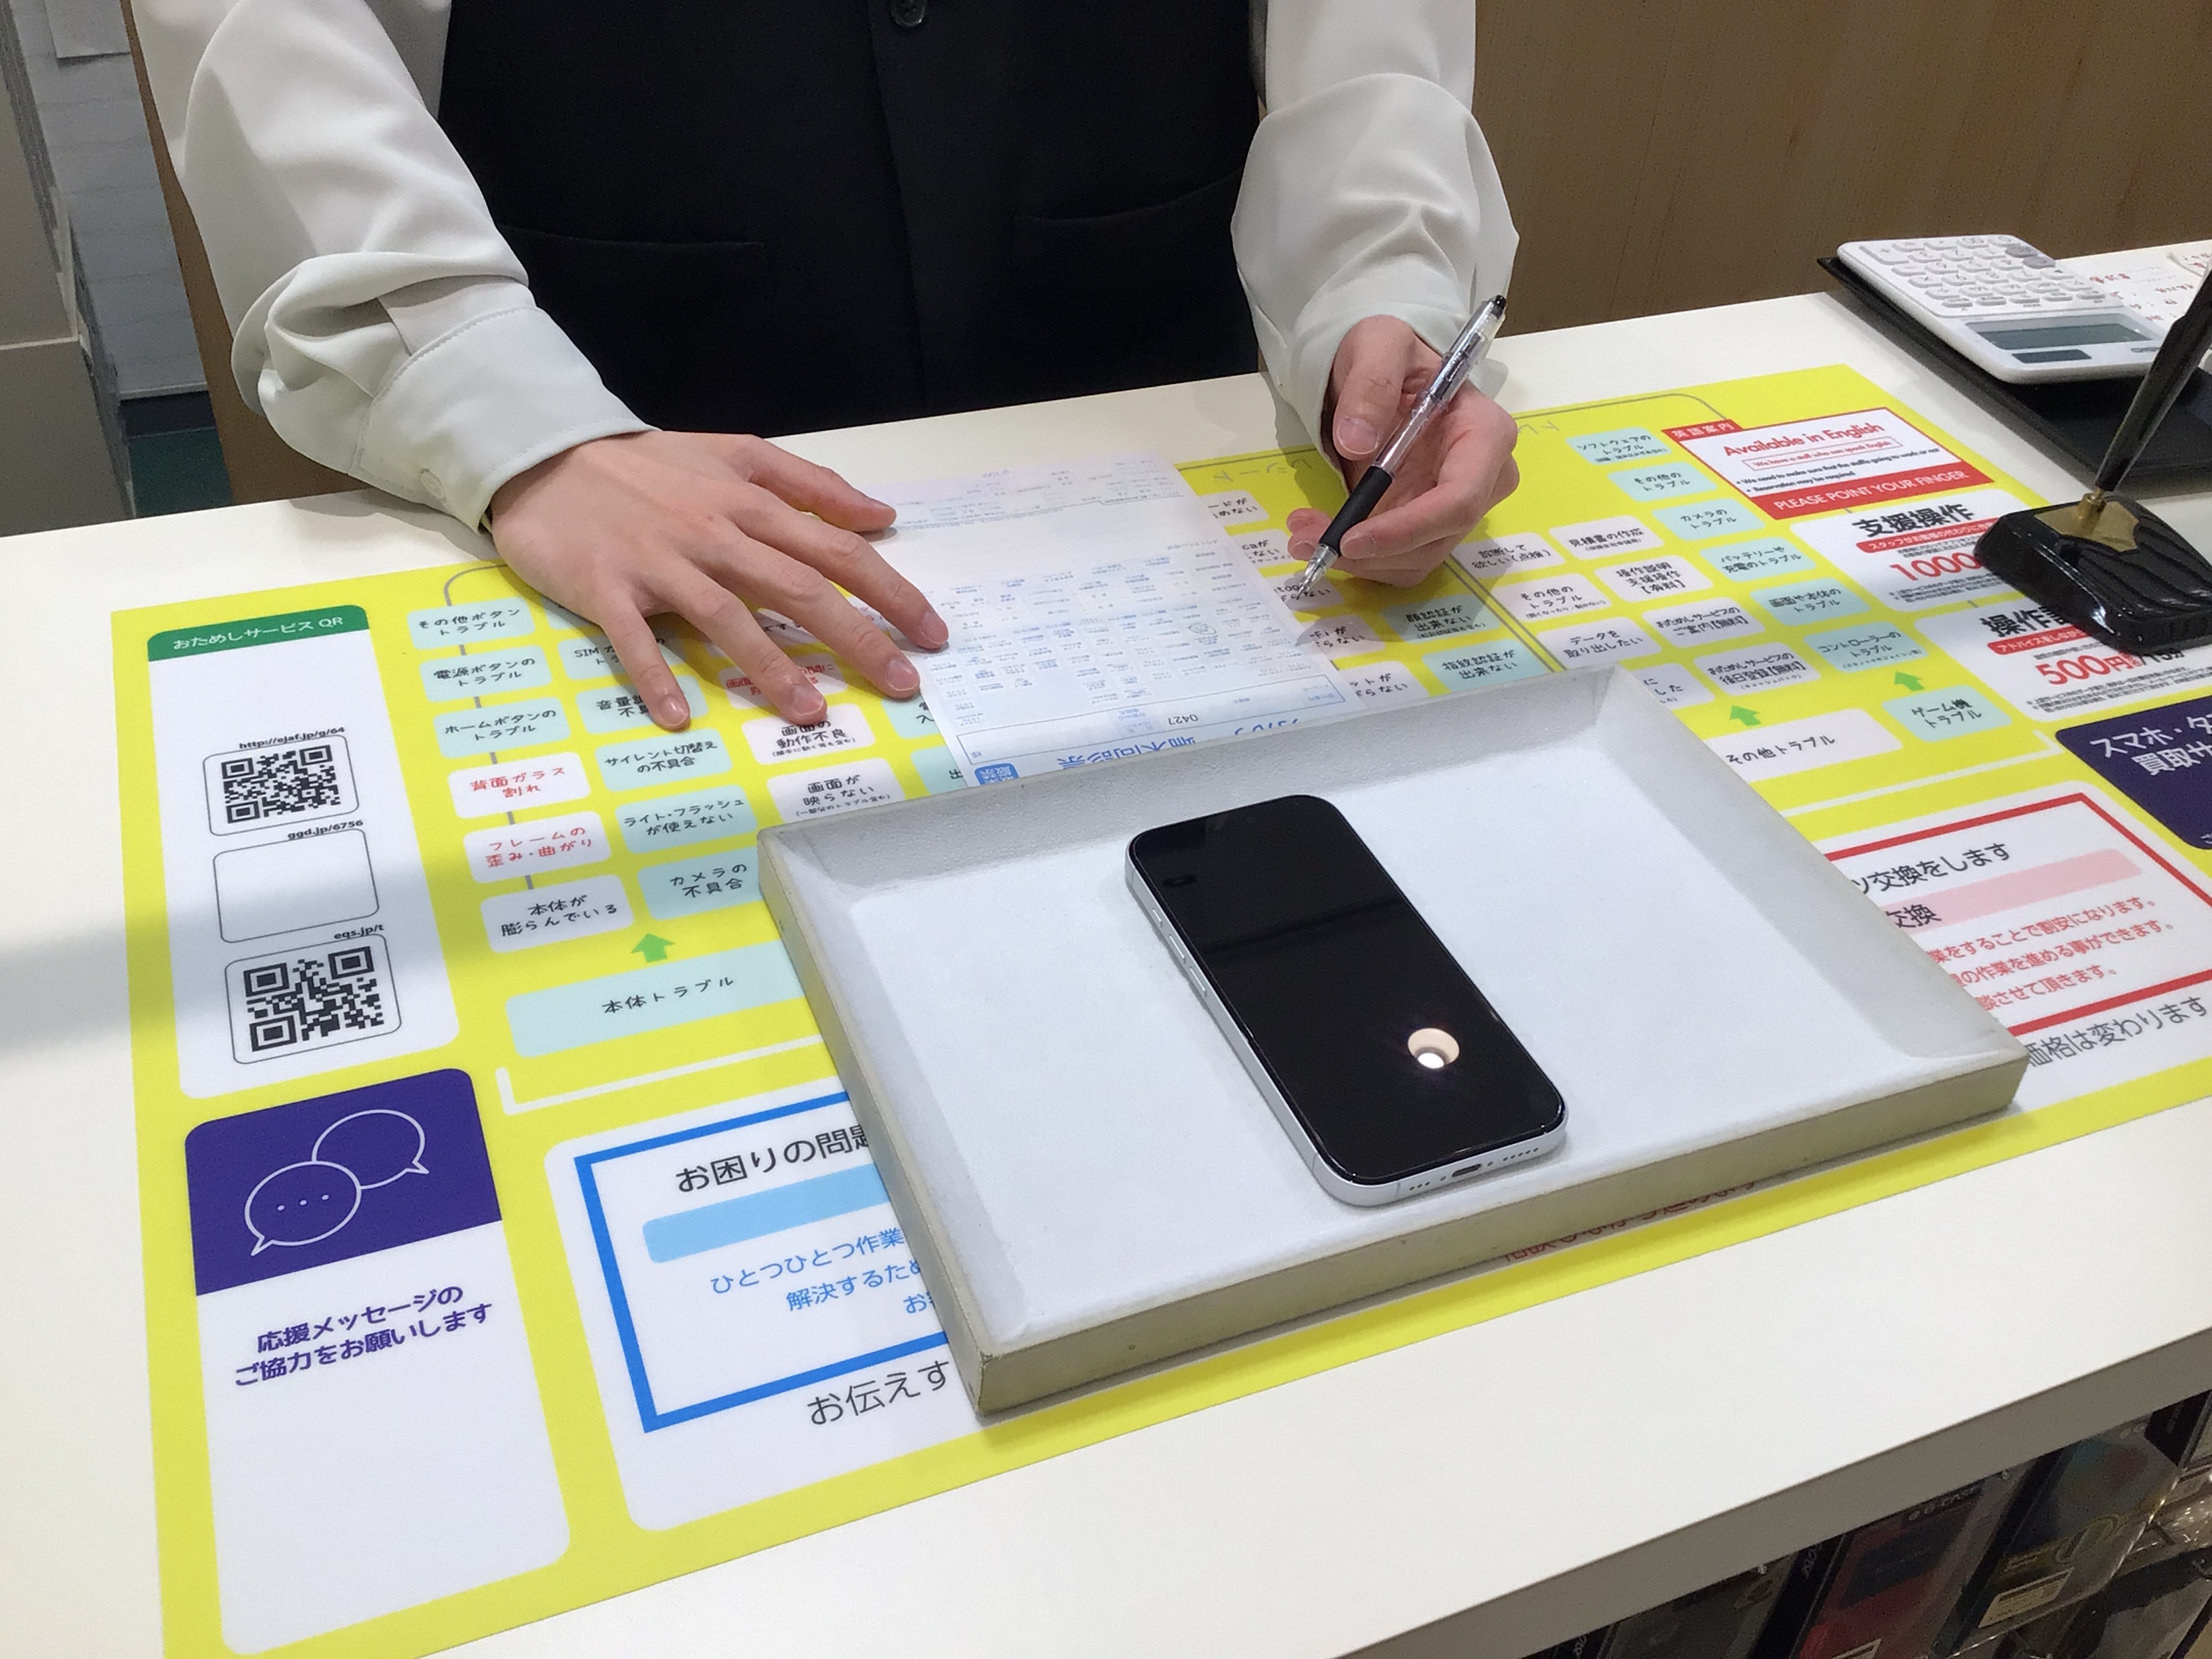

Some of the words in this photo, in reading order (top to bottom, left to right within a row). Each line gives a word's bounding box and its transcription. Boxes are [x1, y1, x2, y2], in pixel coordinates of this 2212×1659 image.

[1671, 421, 1734, 441] 英語案内
[1723, 436, 1804, 457] Available
[1805, 432, 1823, 444] in
[1826, 422, 1886, 442] English
[1576, 434, 1652, 451] ソフトウェアの
[1602, 444, 1644, 455] トラブル
[1633, 471, 1681, 485] その他の
[1643, 478, 1691, 492] トラブル
[1773, 492, 1826, 511] PLEASE
[1828, 485, 1872, 501] POINT
[1872, 478, 1915, 495] YOUR
[1916, 470, 1969, 488] FINGER
[1208, 497, 1248, 509] ードが
[1679, 509, 1728, 523] カメラの
[1691, 516, 1737, 530] トラブル
[1851, 503, 1975, 538] 支援操作
[1569, 527, 1645, 548] 見積書の作成
[1477, 544, 1527, 559] 診断して
[1720, 545, 1786, 563] バッテリーや
[1616, 561, 1673, 579] 操作説明
[1722, 553, 1802, 573] 充電のトラブル
[1889, 552, 1983, 581] 1000
[1626, 570, 1681, 588] 支援操作
[1520, 586, 1574, 601] その他の
[1529, 594, 1583, 610] トラブル
[1769, 588, 1843, 609] 画面や本体の
[1405, 605, 1463, 623] 顔認証が
[1793, 598, 1841, 614] トラブル
[419, 609, 520, 629] その他ボタン
[440, 620, 506, 636] トラブル
[1414, 615, 1473, 632] 出来ない
[1656, 606, 1741, 629] おためしサービスの
[173, 620, 314, 651] おためしサービス
[319, 616, 344, 628] QR
[1570, 630, 1621, 645] データを
[1818, 631, 1902, 653] コントローラーの
[1563, 636, 1644, 660] 取り出したい
[1851, 644, 1893, 658] トラブル
[434, 657, 535, 680] 電源ボタンの
[1442, 649, 1516, 672] 指紋認証が
[1458, 661, 1518, 680] 出来ない
[1707, 652, 1795, 677] おためしサービスの
[2035, 655, 2134, 686] 500円
[458, 670, 522, 687] トラブル
[1911, 697, 1973, 720] ゲーム機
[1925, 708, 1982, 729] トラブル
[444, 710, 557, 735] ホームボタンの
[781, 720, 831, 737] 画面の
[1168, 713, 1199, 727] 0427
[474, 724, 537, 741] トラブル
[776, 728, 848, 750] 動作不良
[2089, 713, 2212, 758] スマホ・タ
[605, 741, 718, 766] サイレント切替え
[1725, 734, 1836, 766] その他トラブル
[636, 756, 696, 773] の不具合
[470, 766, 567, 792] 背面ガラス
[807, 774, 861, 794] 画面が
[501, 784, 541, 798] 割れ
[802, 785, 874, 806] 映らない
[623, 799, 745, 827] ライト・フラッシュ
[645, 813, 733, 836] が使えない
[488, 826, 586, 851] フレームの
[485, 838, 593, 868] 歪み・曲がり
[670, 863, 747, 886] カメラの
[682, 878, 743, 899] 不具合
[527, 894, 588, 916] 本体が
[501, 903, 617, 937] 膨らんでいる
[333, 924, 385, 940] eqs.jp/t
[602, 975, 735, 1015] 本体トラブル
[2024, 996, 2208, 1068] 価格は変わります
[710, 1227, 906, 1296] ひとつひとつ作業
[256, 1284, 466, 1354] 応援メッセージの
[233, 1301, 494, 1388] ご協力をお願いします
[806, 1358, 951, 1427] お伝えす
